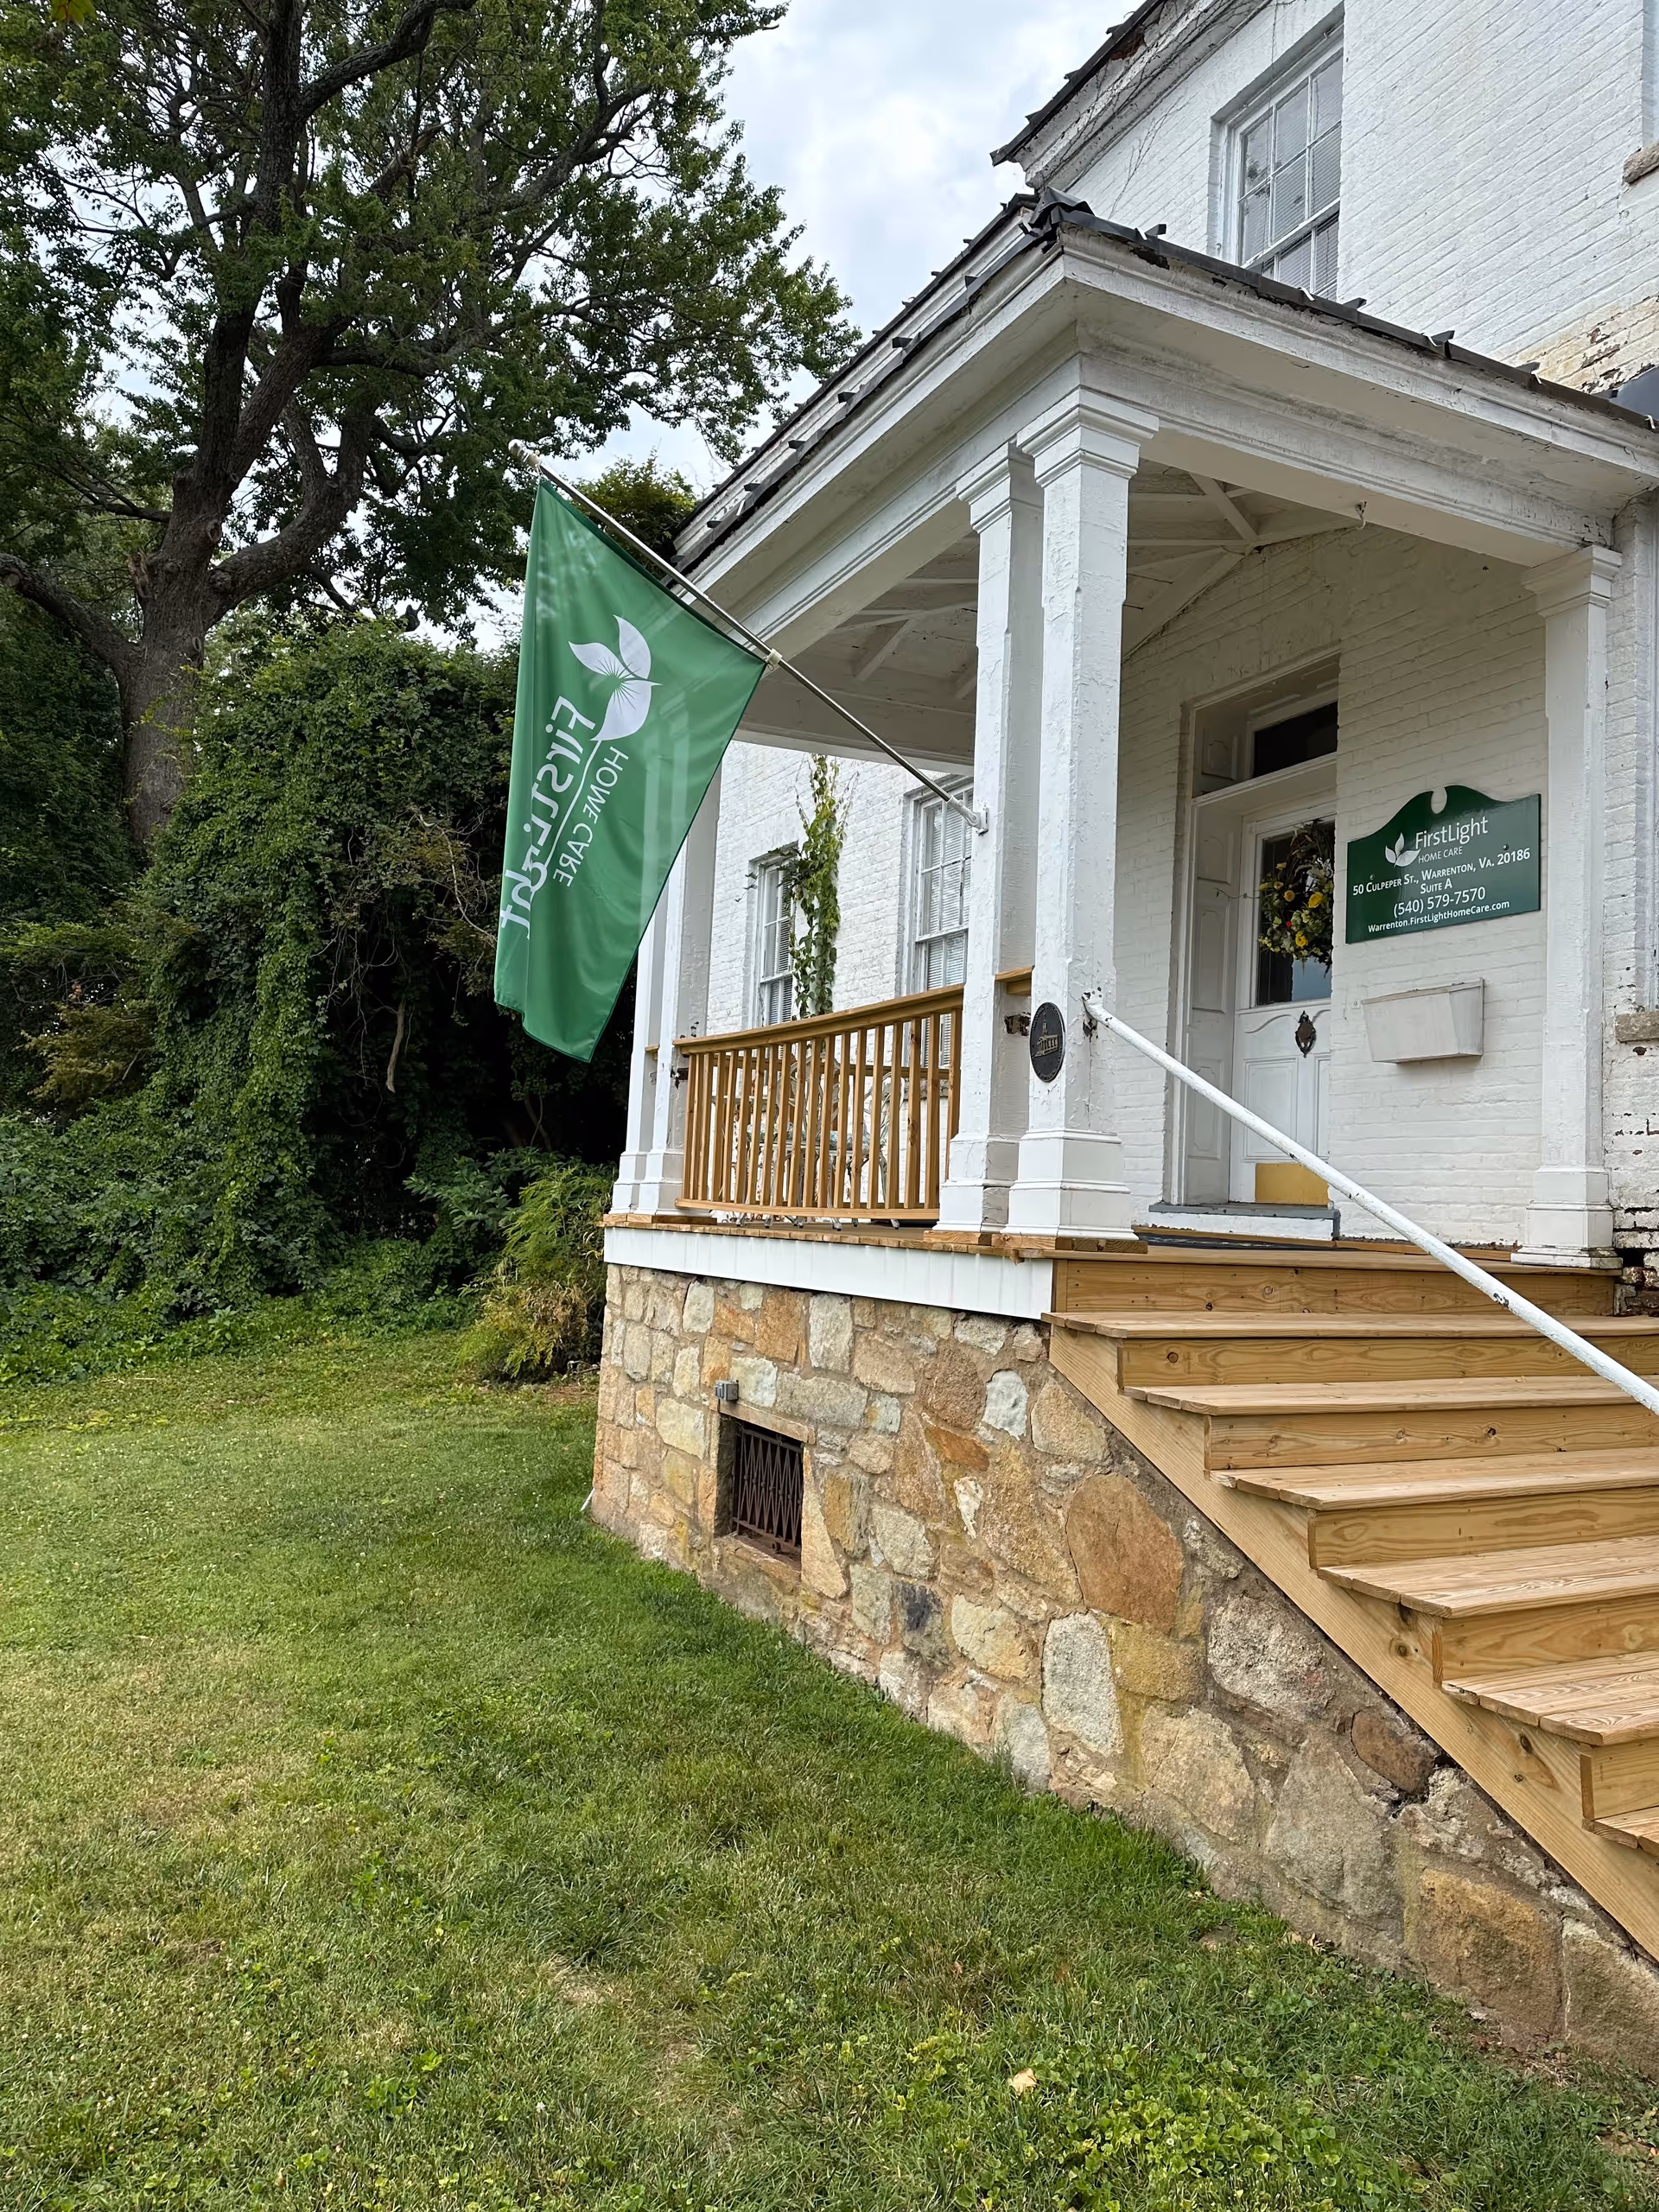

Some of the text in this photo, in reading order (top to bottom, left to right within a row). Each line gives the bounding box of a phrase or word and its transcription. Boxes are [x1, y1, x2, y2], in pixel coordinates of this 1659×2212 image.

[1415, 816, 1488, 849] FirstLight
[1418, 846, 1463, 864] HOME CARE
[1352, 884, 1364, 896] 50
[1497, 848, 1530, 865] 20186
[1445, 878, 1452, 889] A
[1368, 900, 1510, 933] Warrenton.FirstLightHomeCare.com
[1393, 887, 1486, 918] (540) 579-7570
